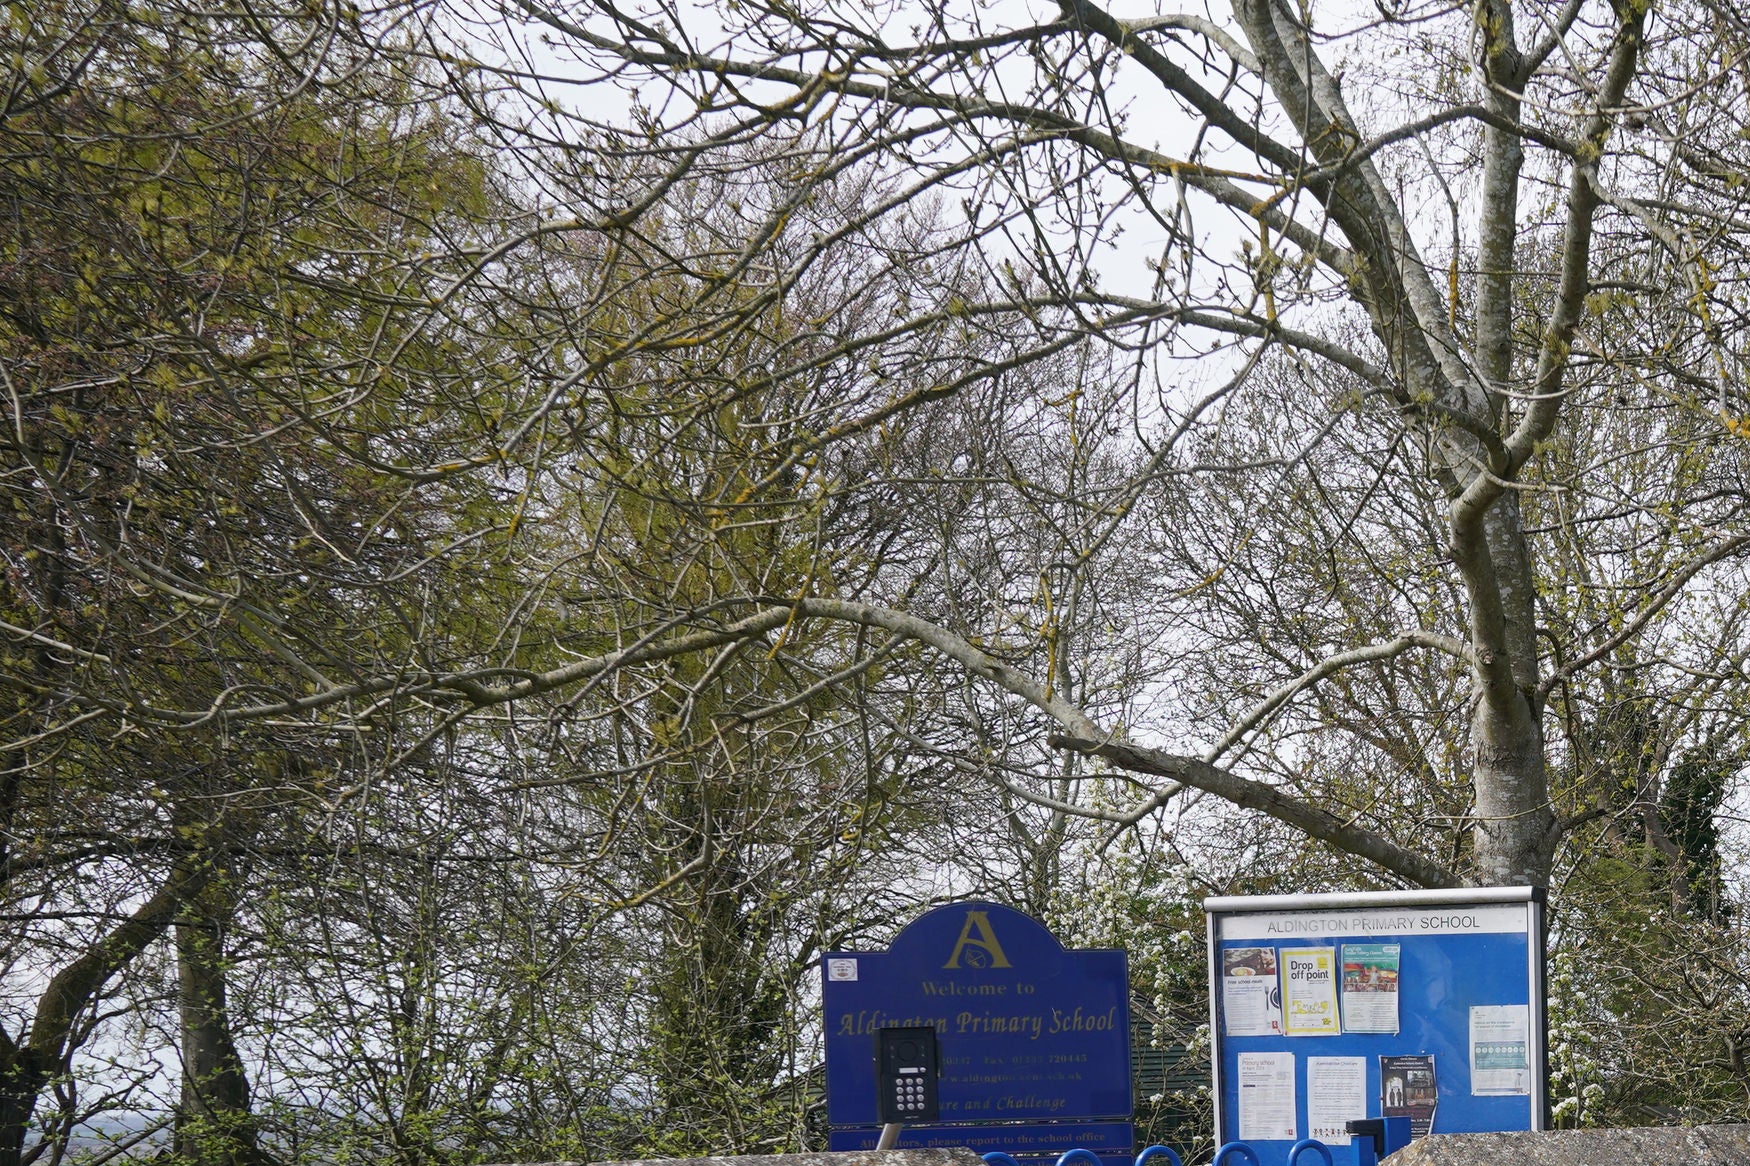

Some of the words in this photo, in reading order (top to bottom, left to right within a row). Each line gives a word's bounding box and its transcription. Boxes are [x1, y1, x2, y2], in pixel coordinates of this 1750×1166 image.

[1267, 918, 1348, 933] ALDINGTON
[1352, 916, 1415, 931] PRIMARY
[1419, 915, 1481, 929] SCHOOL
[943, 911, 1012, 969] A
[1290, 960, 1313, 971] Drop
[1290, 970, 1304, 979] off
[1306, 969, 1329, 981] point
[921, 981, 1007, 996] Welcome
[1015, 982, 1035, 996] to
[956, 1010, 1043, 1040] Primary
[1048, 1005, 1118, 1035] School
[964, 1096, 993, 1110] and
[996, 1094, 1067, 1111] Challenge
[927, 1137, 962, 1149] please
[965, 1135, 1000, 1148] report
[1003, 1135, 1014, 1145] to
[1017, 1134, 1034, 1144] the
[1037, 1133, 1072, 1143] school
[1075, 1132, 1105, 1143] office
